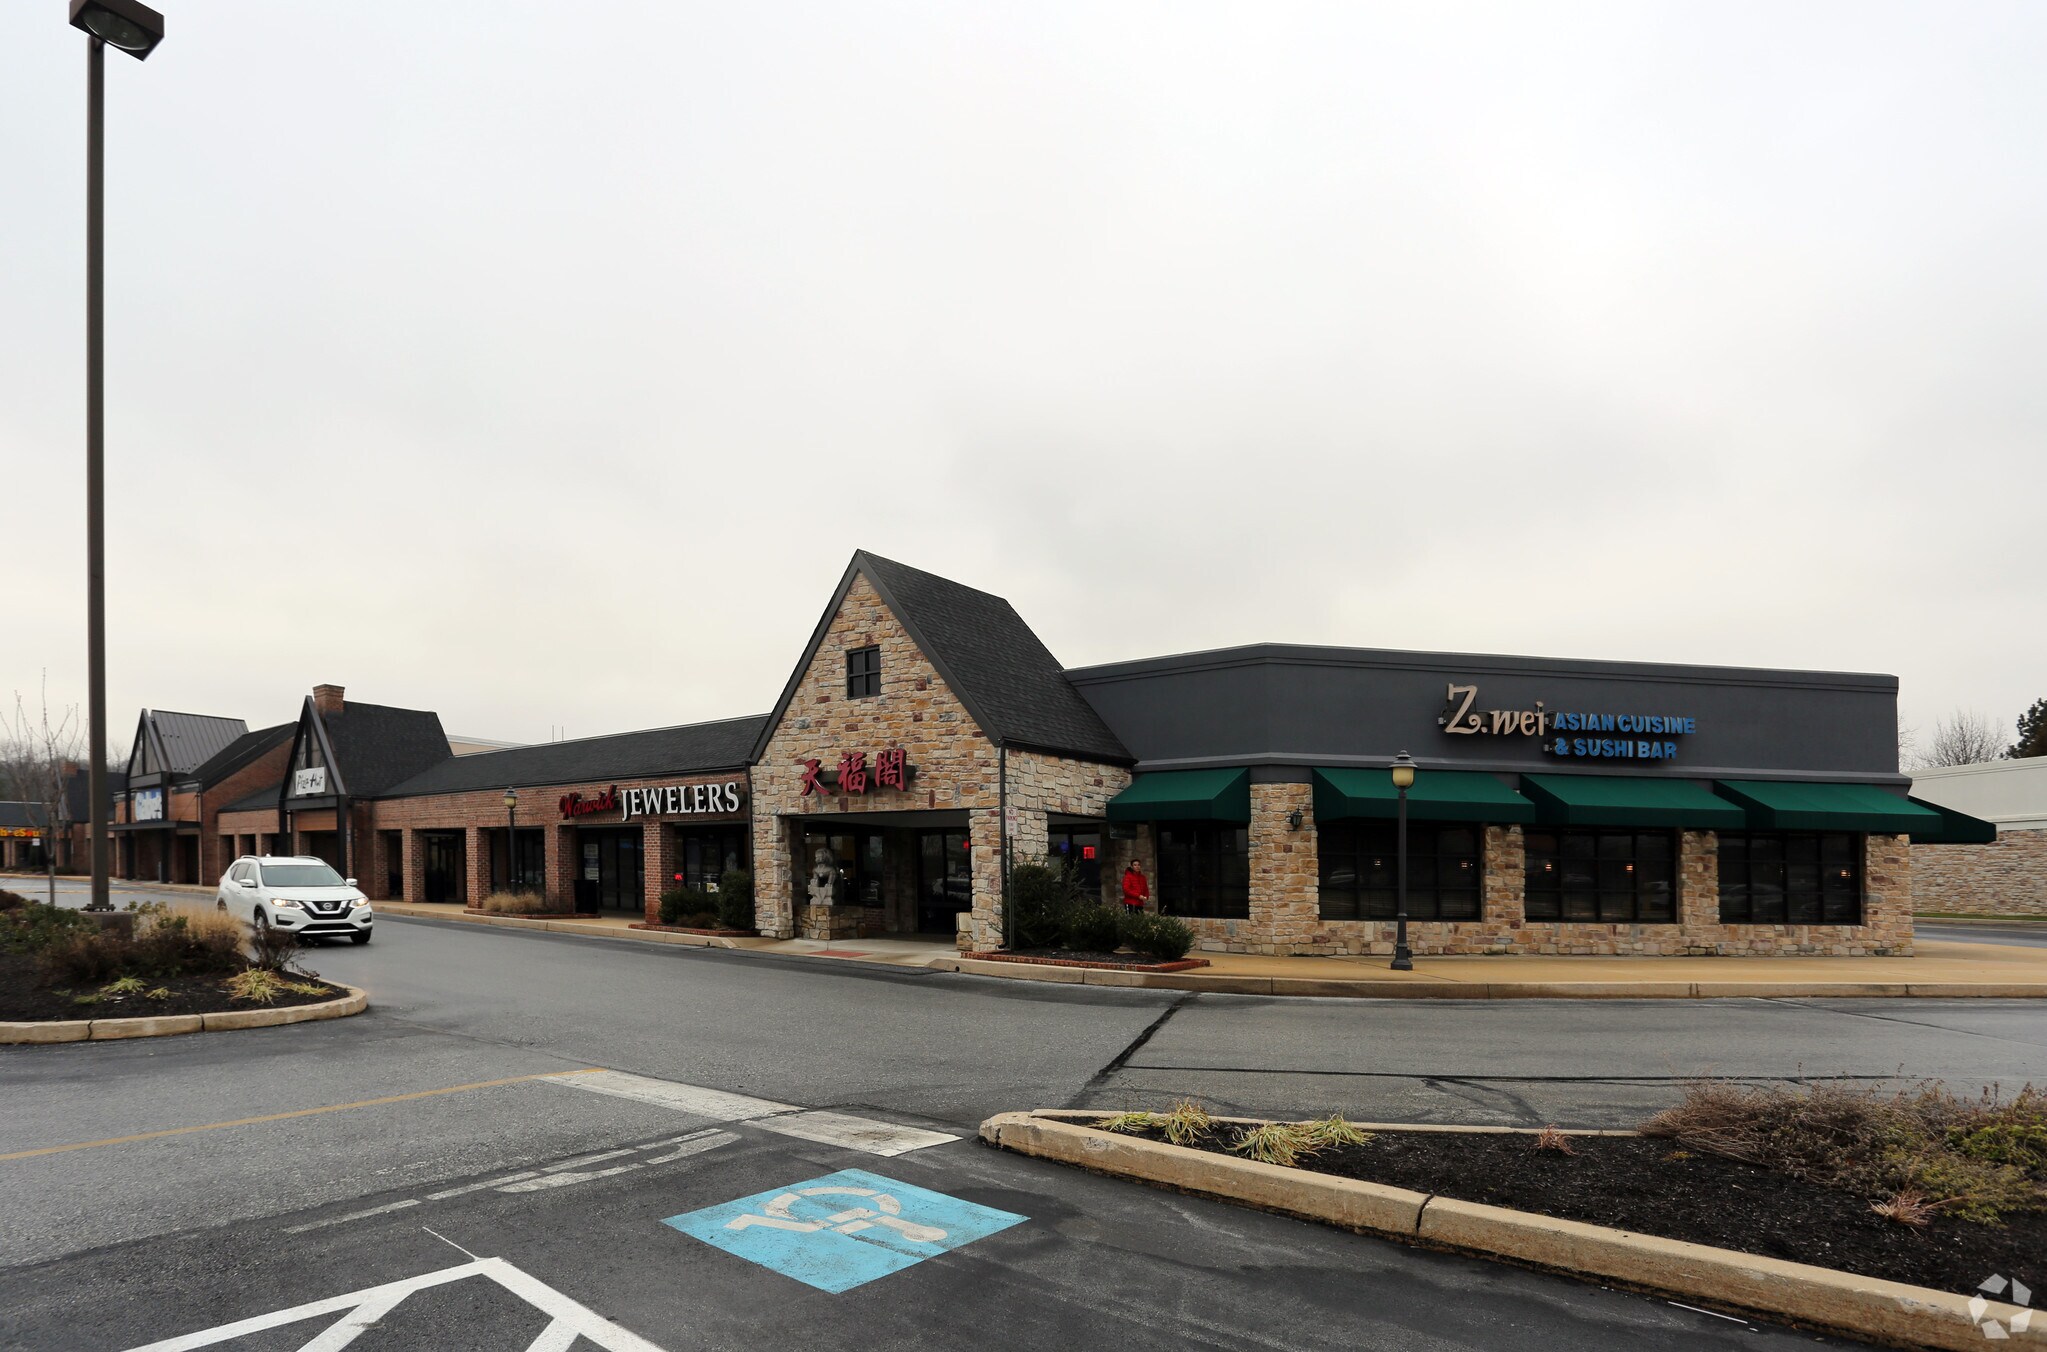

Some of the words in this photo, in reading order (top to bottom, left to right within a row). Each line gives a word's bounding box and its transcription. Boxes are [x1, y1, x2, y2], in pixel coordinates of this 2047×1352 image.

[1444, 683, 1545, 736] Z.wei
[1553, 712, 1615, 732] ASIAN
[1617, 714, 1696, 734] CUISINE
[1554, 738, 1570, 755] &
[1574, 738, 1634, 758] SUSHI
[1636, 740, 1677, 759] BAR
[559, 785, 616, 819] Warwick
[621, 782, 740, 821] JEWELERS
